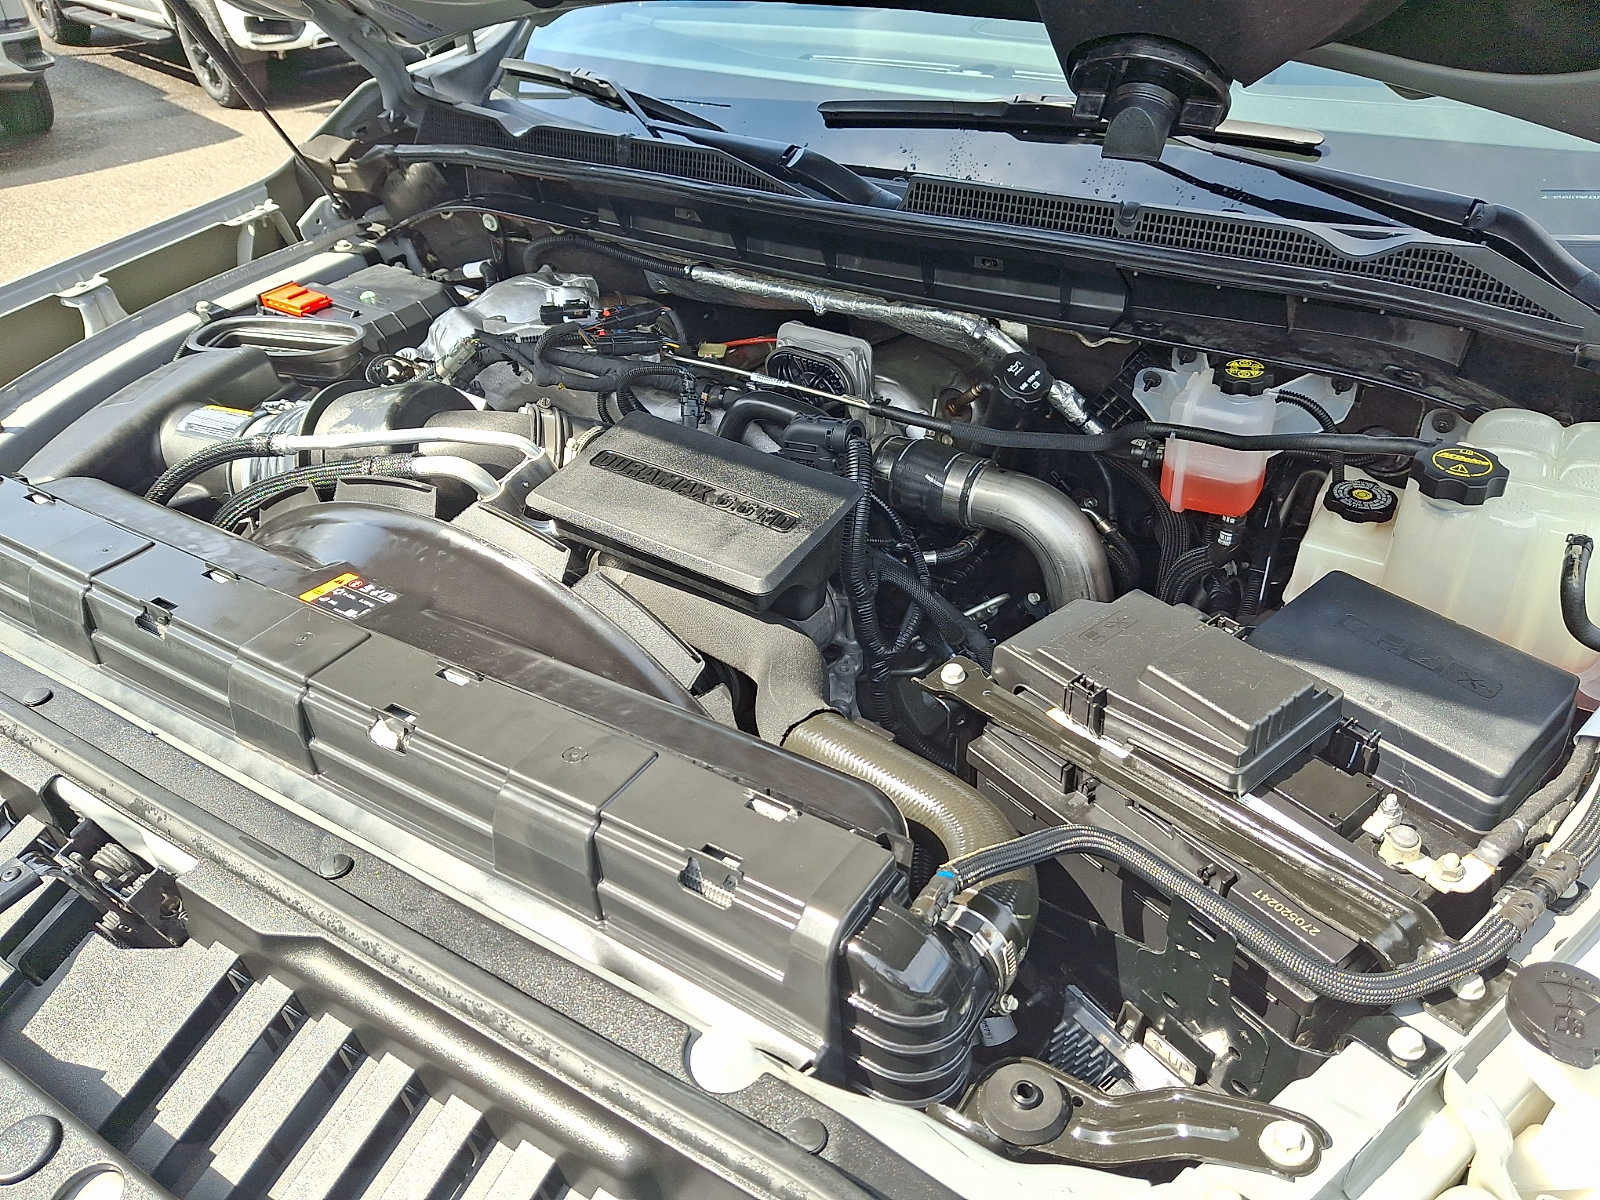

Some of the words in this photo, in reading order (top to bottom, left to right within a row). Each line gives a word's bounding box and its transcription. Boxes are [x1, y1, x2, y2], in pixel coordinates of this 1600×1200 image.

[596, 453, 715, 502] DURAMAX
[757, 506, 798, 532] HD
[1251, 889, 1321, 937] 27052024T
[1167, 1050, 1191, 1072] UP
